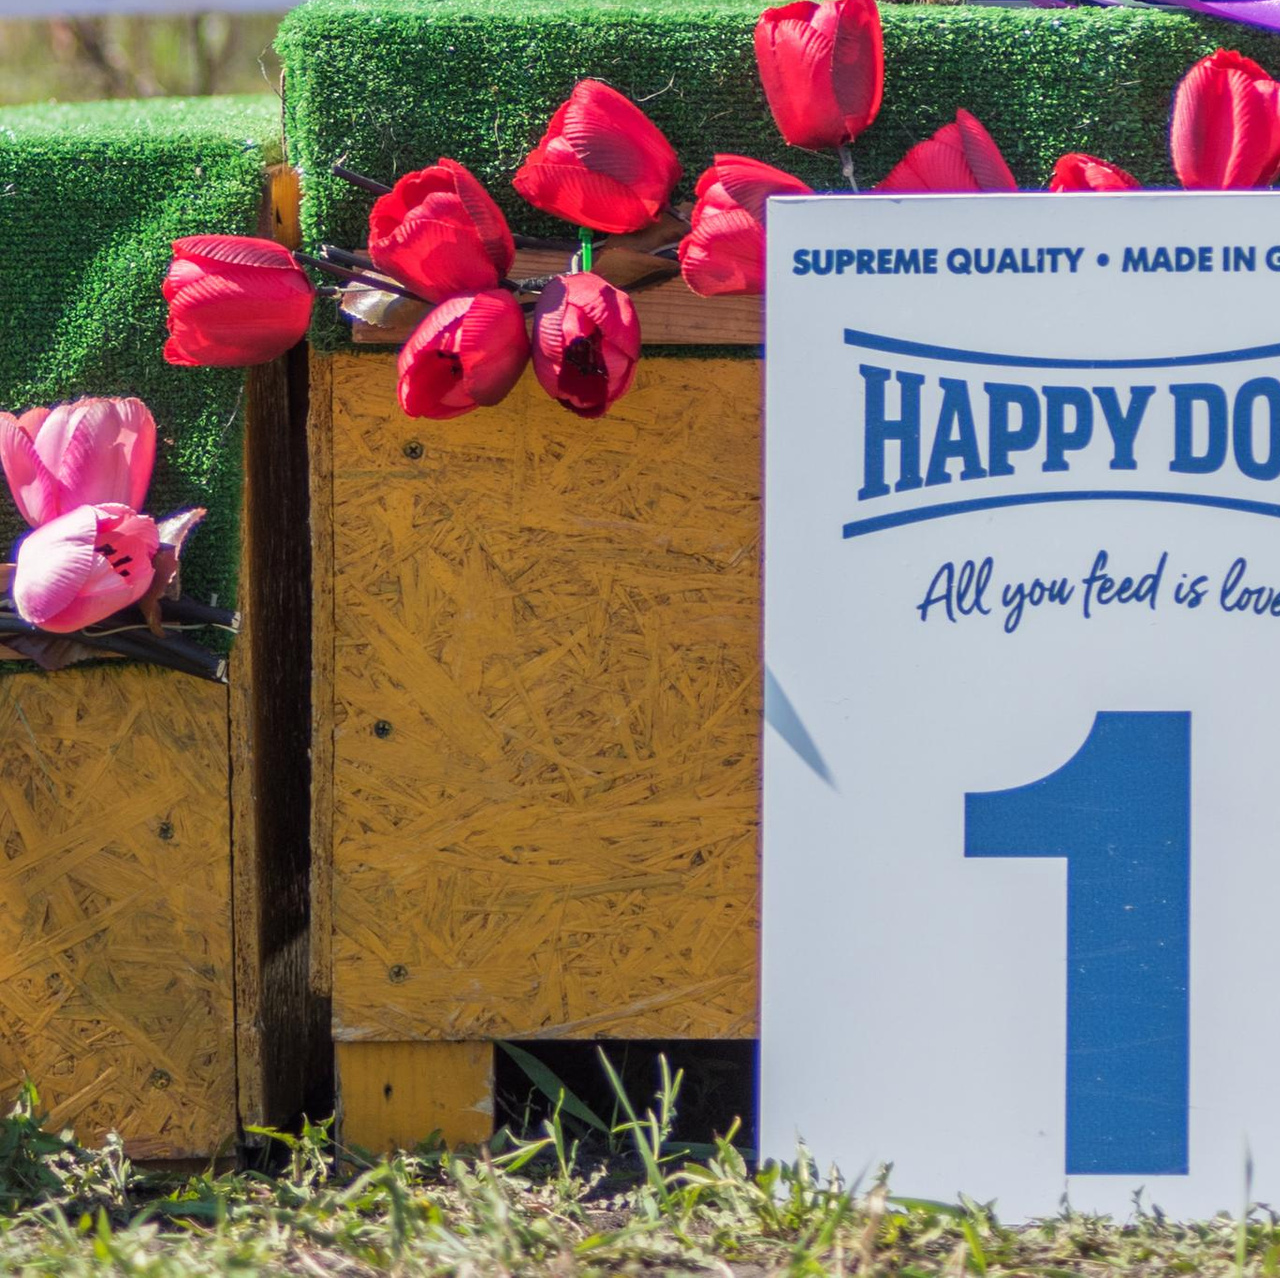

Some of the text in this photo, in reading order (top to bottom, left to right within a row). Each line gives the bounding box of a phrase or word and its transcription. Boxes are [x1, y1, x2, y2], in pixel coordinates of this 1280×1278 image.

[792, 247, 938, 276] SUPREME
[947, 247, 1086, 276] QUALITY
[1121, 246, 1214, 275] MADE
[1221, 246, 1258, 273] IN
[857, 363, 1157, 502] HAPPY
[916, 556, 994, 623] All
[1001, 568, 1076, 634] you
[1082, 549, 1170, 621] feed
[1174, 572, 1210, 608] is
[964, 710, 1192, 1175] 1
